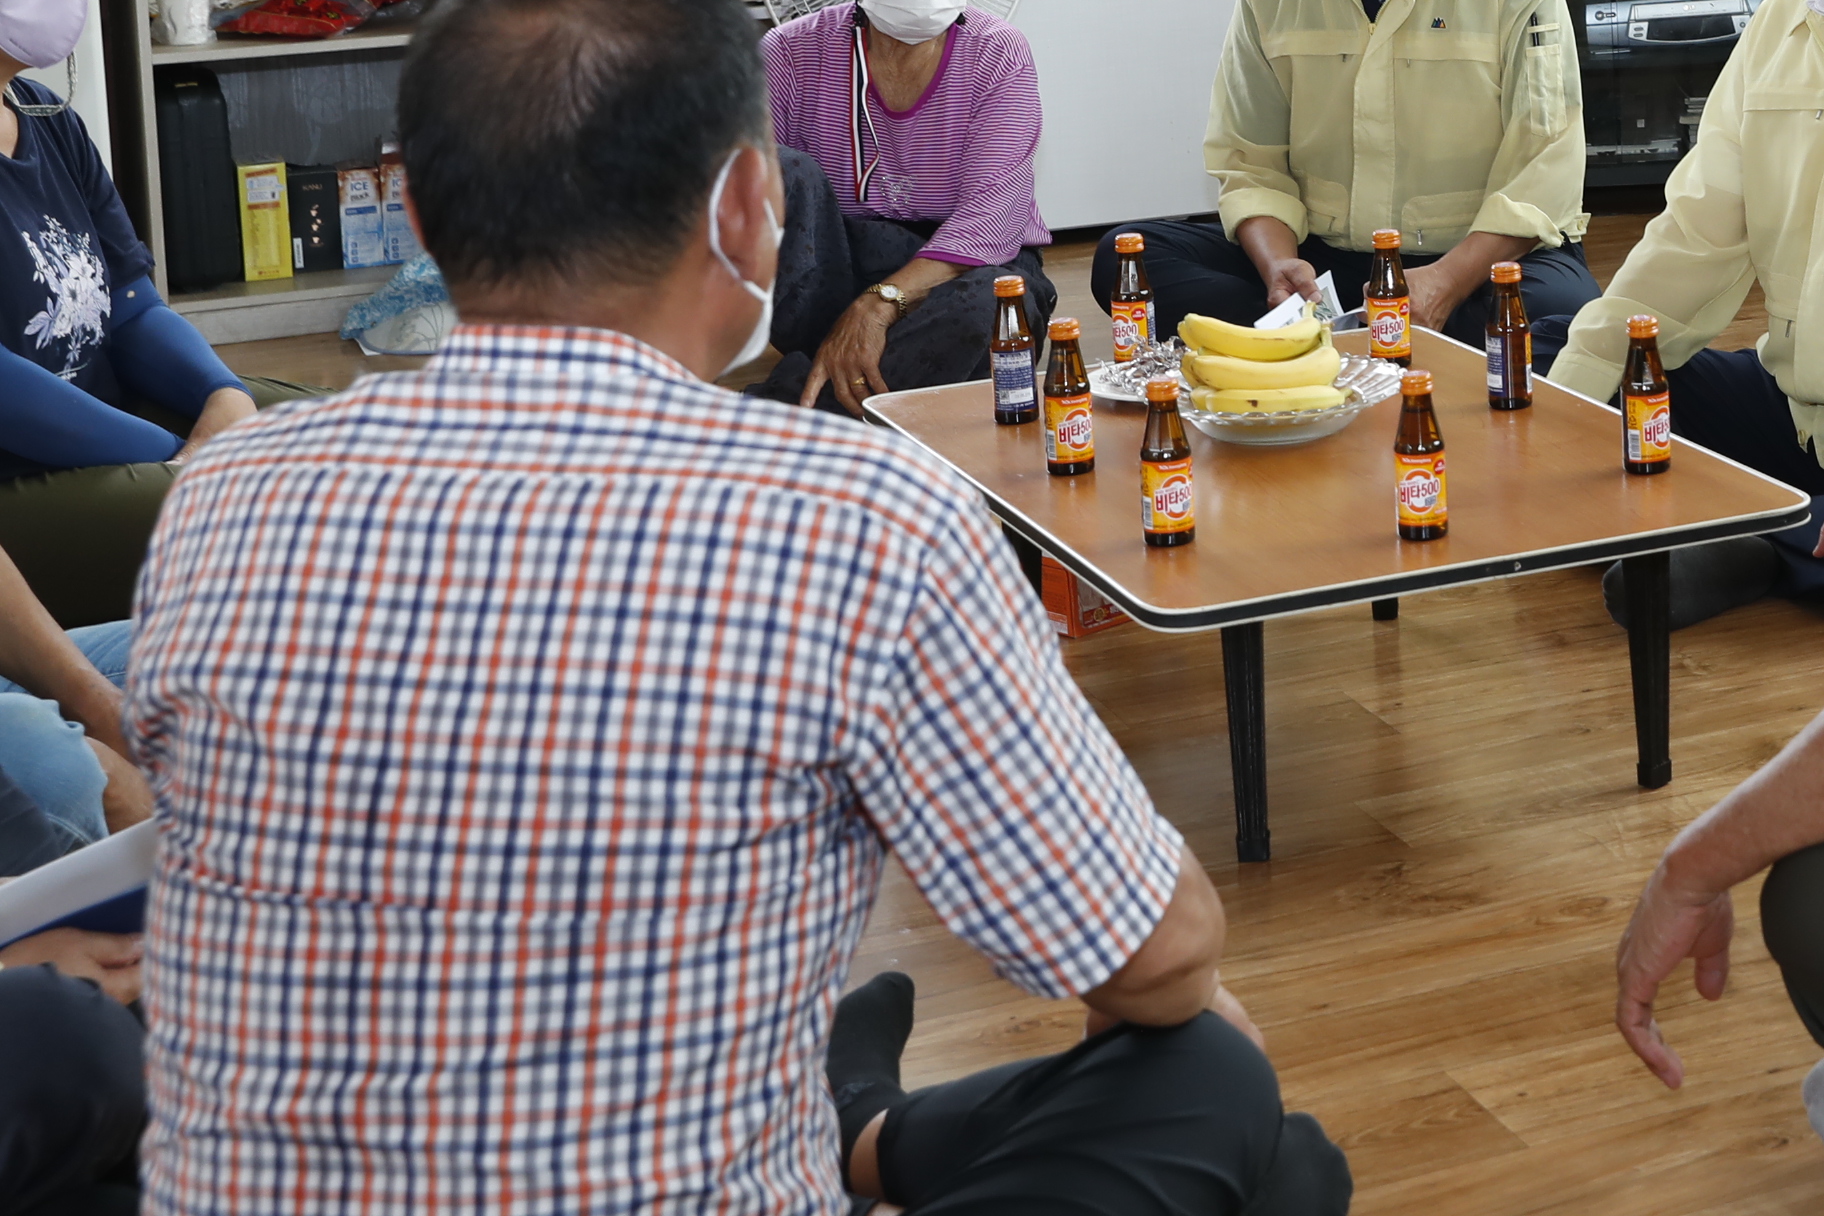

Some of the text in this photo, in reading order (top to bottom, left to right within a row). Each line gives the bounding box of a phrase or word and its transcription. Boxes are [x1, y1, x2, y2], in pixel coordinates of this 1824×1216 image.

[350, 181, 368, 192] ICE
[1372, 319, 1404, 341] 비타500
[1400, 479, 1440, 504] 비타500
